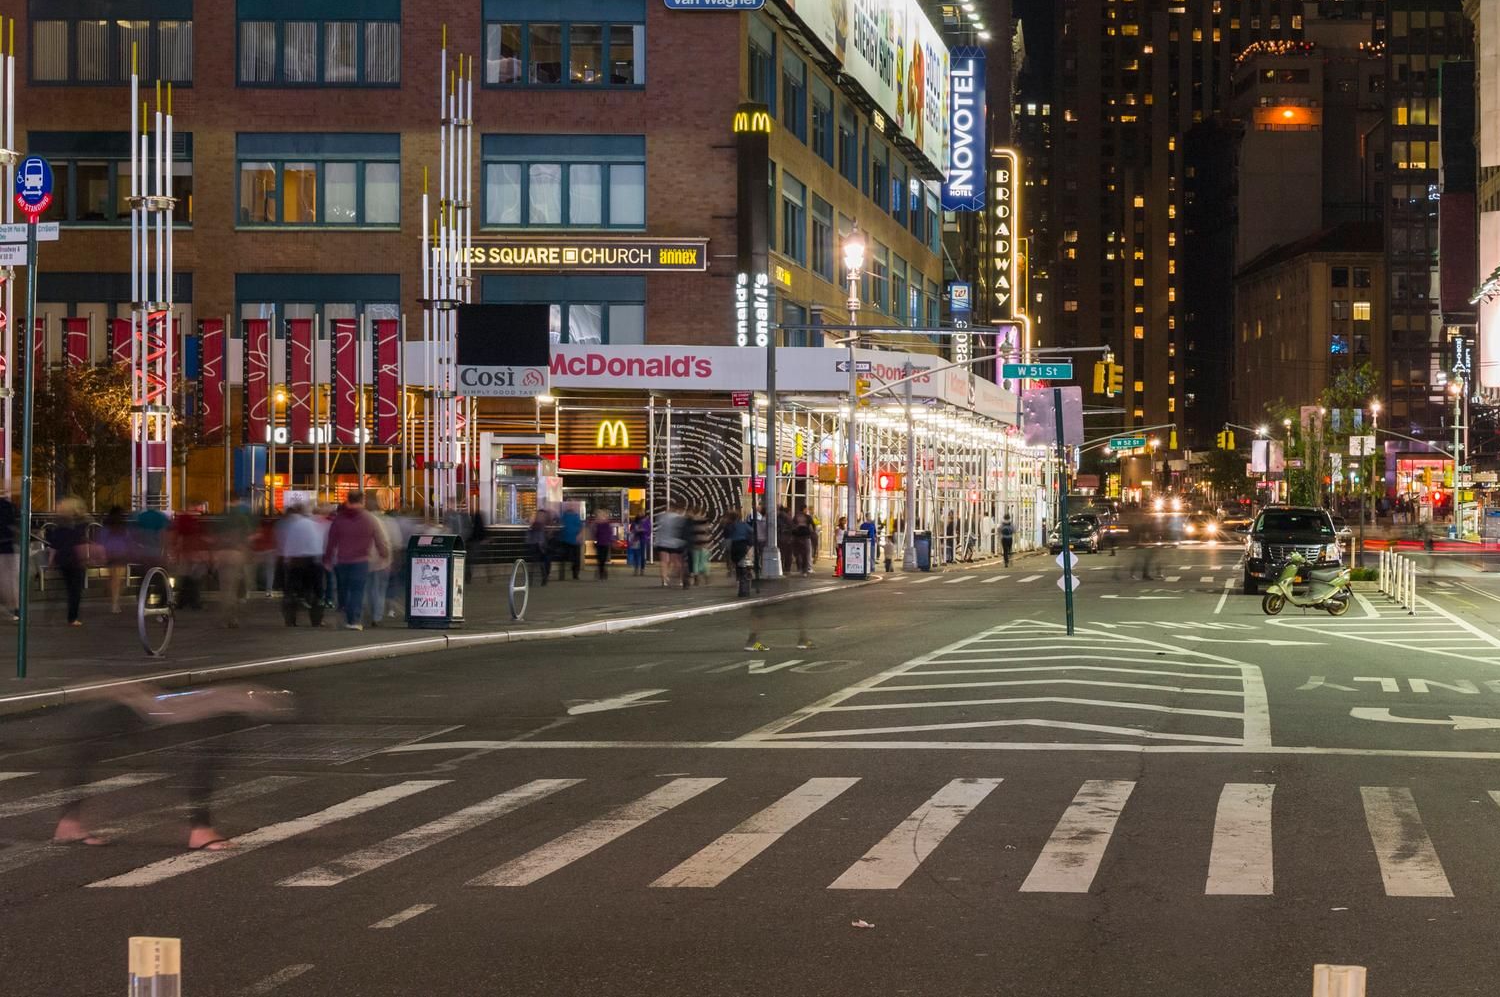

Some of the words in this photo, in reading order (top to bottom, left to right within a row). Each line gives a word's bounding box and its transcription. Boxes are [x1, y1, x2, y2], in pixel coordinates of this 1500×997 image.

[950, 59, 974, 190] NOVOTEL
[950, 189, 972, 197] HOTEL
[17, 195, 25, 207] NO
[24, 195, 49, 213] STANDING
[994, 170, 1010, 306] BROADWAY
[489, 247, 560, 264] SQUARE
[581, 248, 652, 264] CHURCH
[659, 252, 697, 264] annex
[550, 353, 713, 378] McDonald's
[1017, 367, 1028, 376] W
[1030, 367, 1042, 376] 51
[1045, 367, 1057, 376] St
[460, 367, 515, 387] Così
